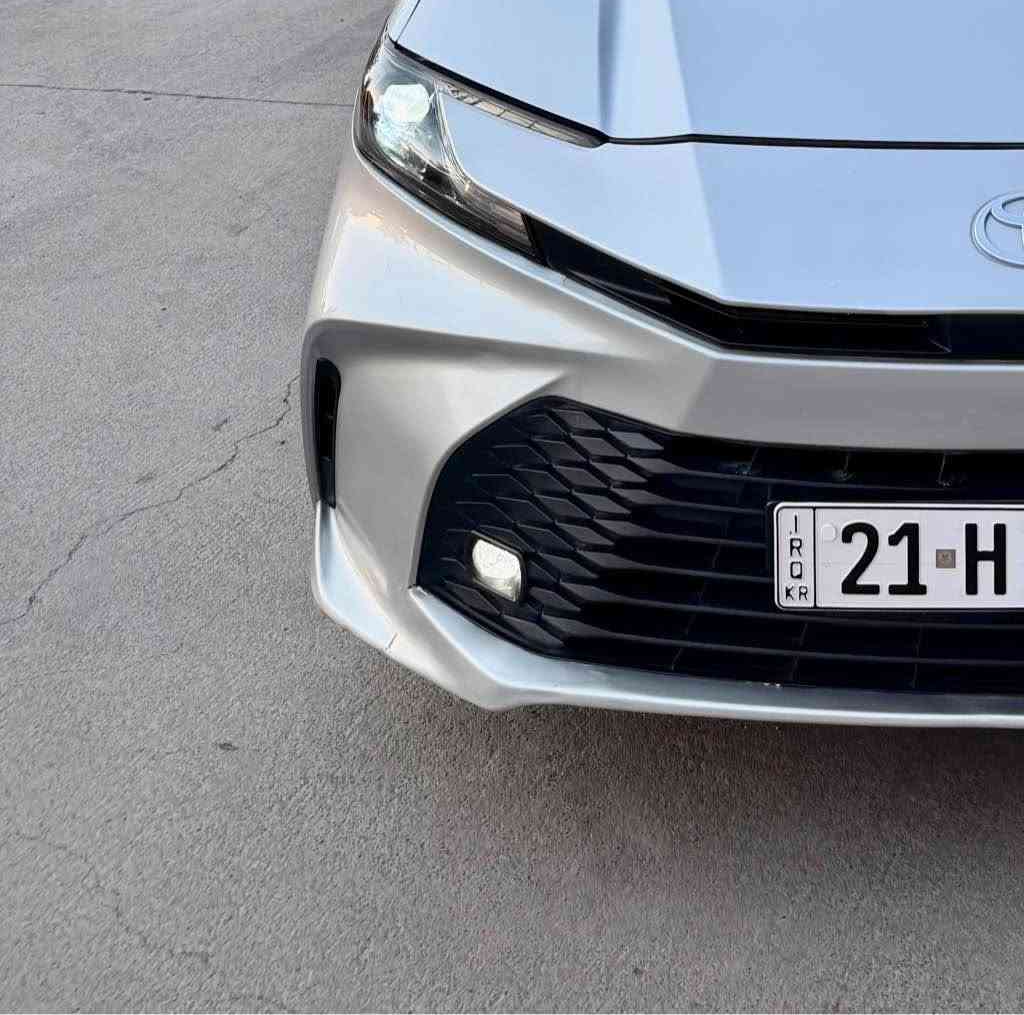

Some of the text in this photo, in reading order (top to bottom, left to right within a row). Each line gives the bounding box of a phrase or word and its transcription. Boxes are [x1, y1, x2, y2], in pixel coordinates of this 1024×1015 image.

[789, 514, 803, 580] IRQ
[841, 522, 928, 596] 21
[965, 522, 1007, 596] H
[785, 585, 808, 601] KR
